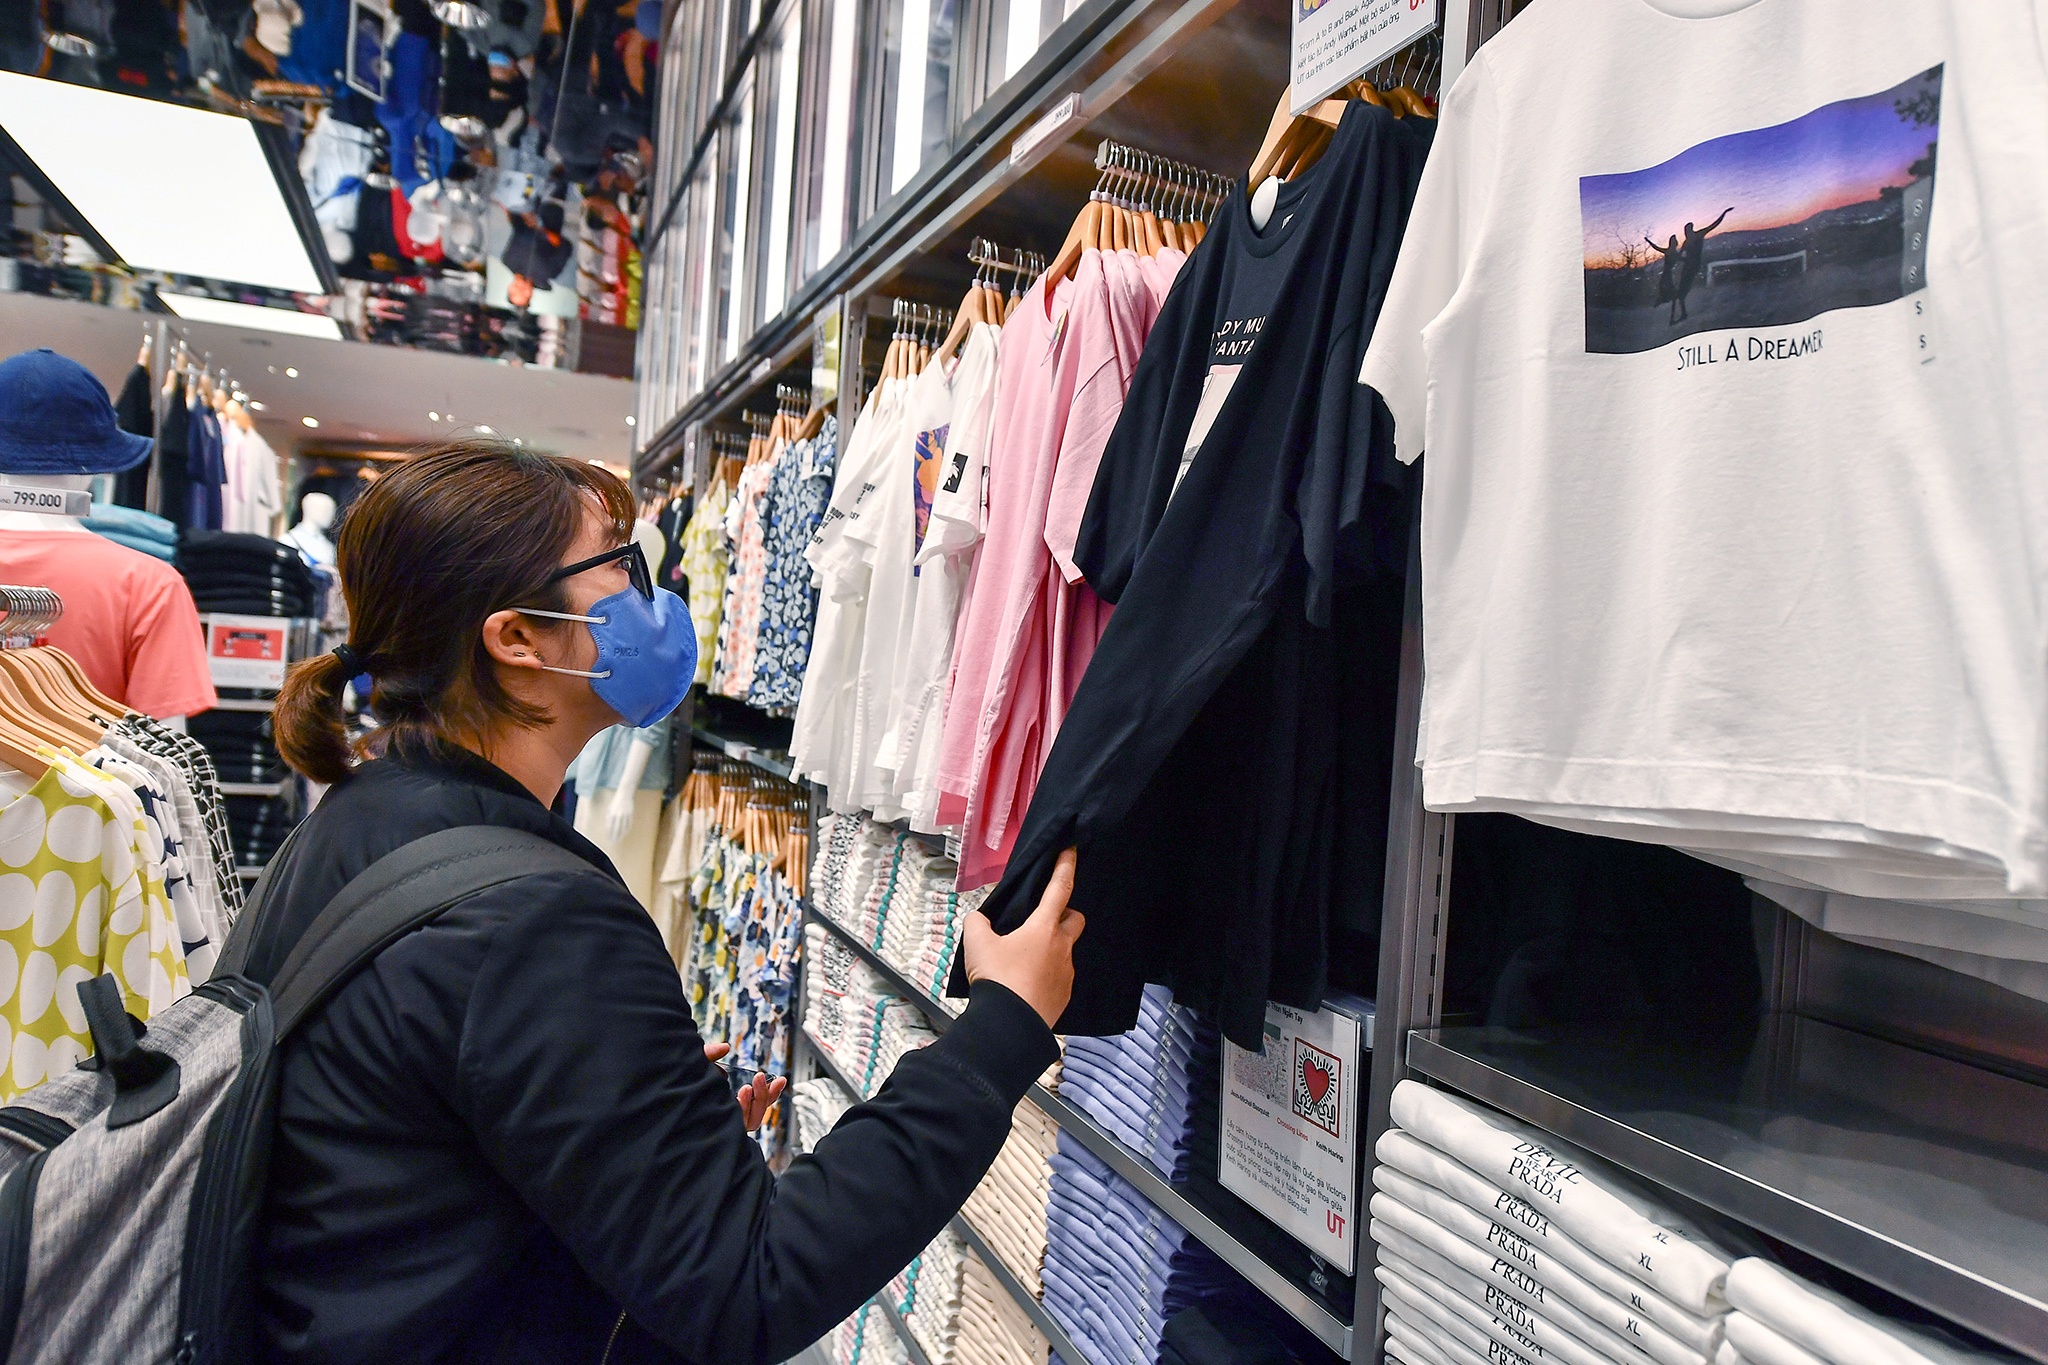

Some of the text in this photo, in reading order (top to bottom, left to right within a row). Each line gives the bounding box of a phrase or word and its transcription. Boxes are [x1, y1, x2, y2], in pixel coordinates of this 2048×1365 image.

[1328, 23, 1333, 33] B
[1334, 14, 1343, 29] and
[1345, 5, 1359, 20] Back
[1677, 330, 1823, 370] STILL A DREAMER
[14, 491, 62, 507] 799.000
[614, 647, 640, 657] PM2.5
[1507, 1156, 1562, 1204] PRADA
[1525, 1158, 1558, 1182] WEARS
[1326, 1181, 1346, 1202] Victoria
[1327, 1209, 1345, 1239] UT
[1494, 1192, 1548, 1238] PRADA
[1486, 1222, 1537, 1270] PRADA
[1638, 1252, 1653, 1272] XL
[1485, 1283, 1536, 1336] PRADA
[1631, 1292, 1645, 1312] XL
[1626, 1318, 1641, 1336] XL
